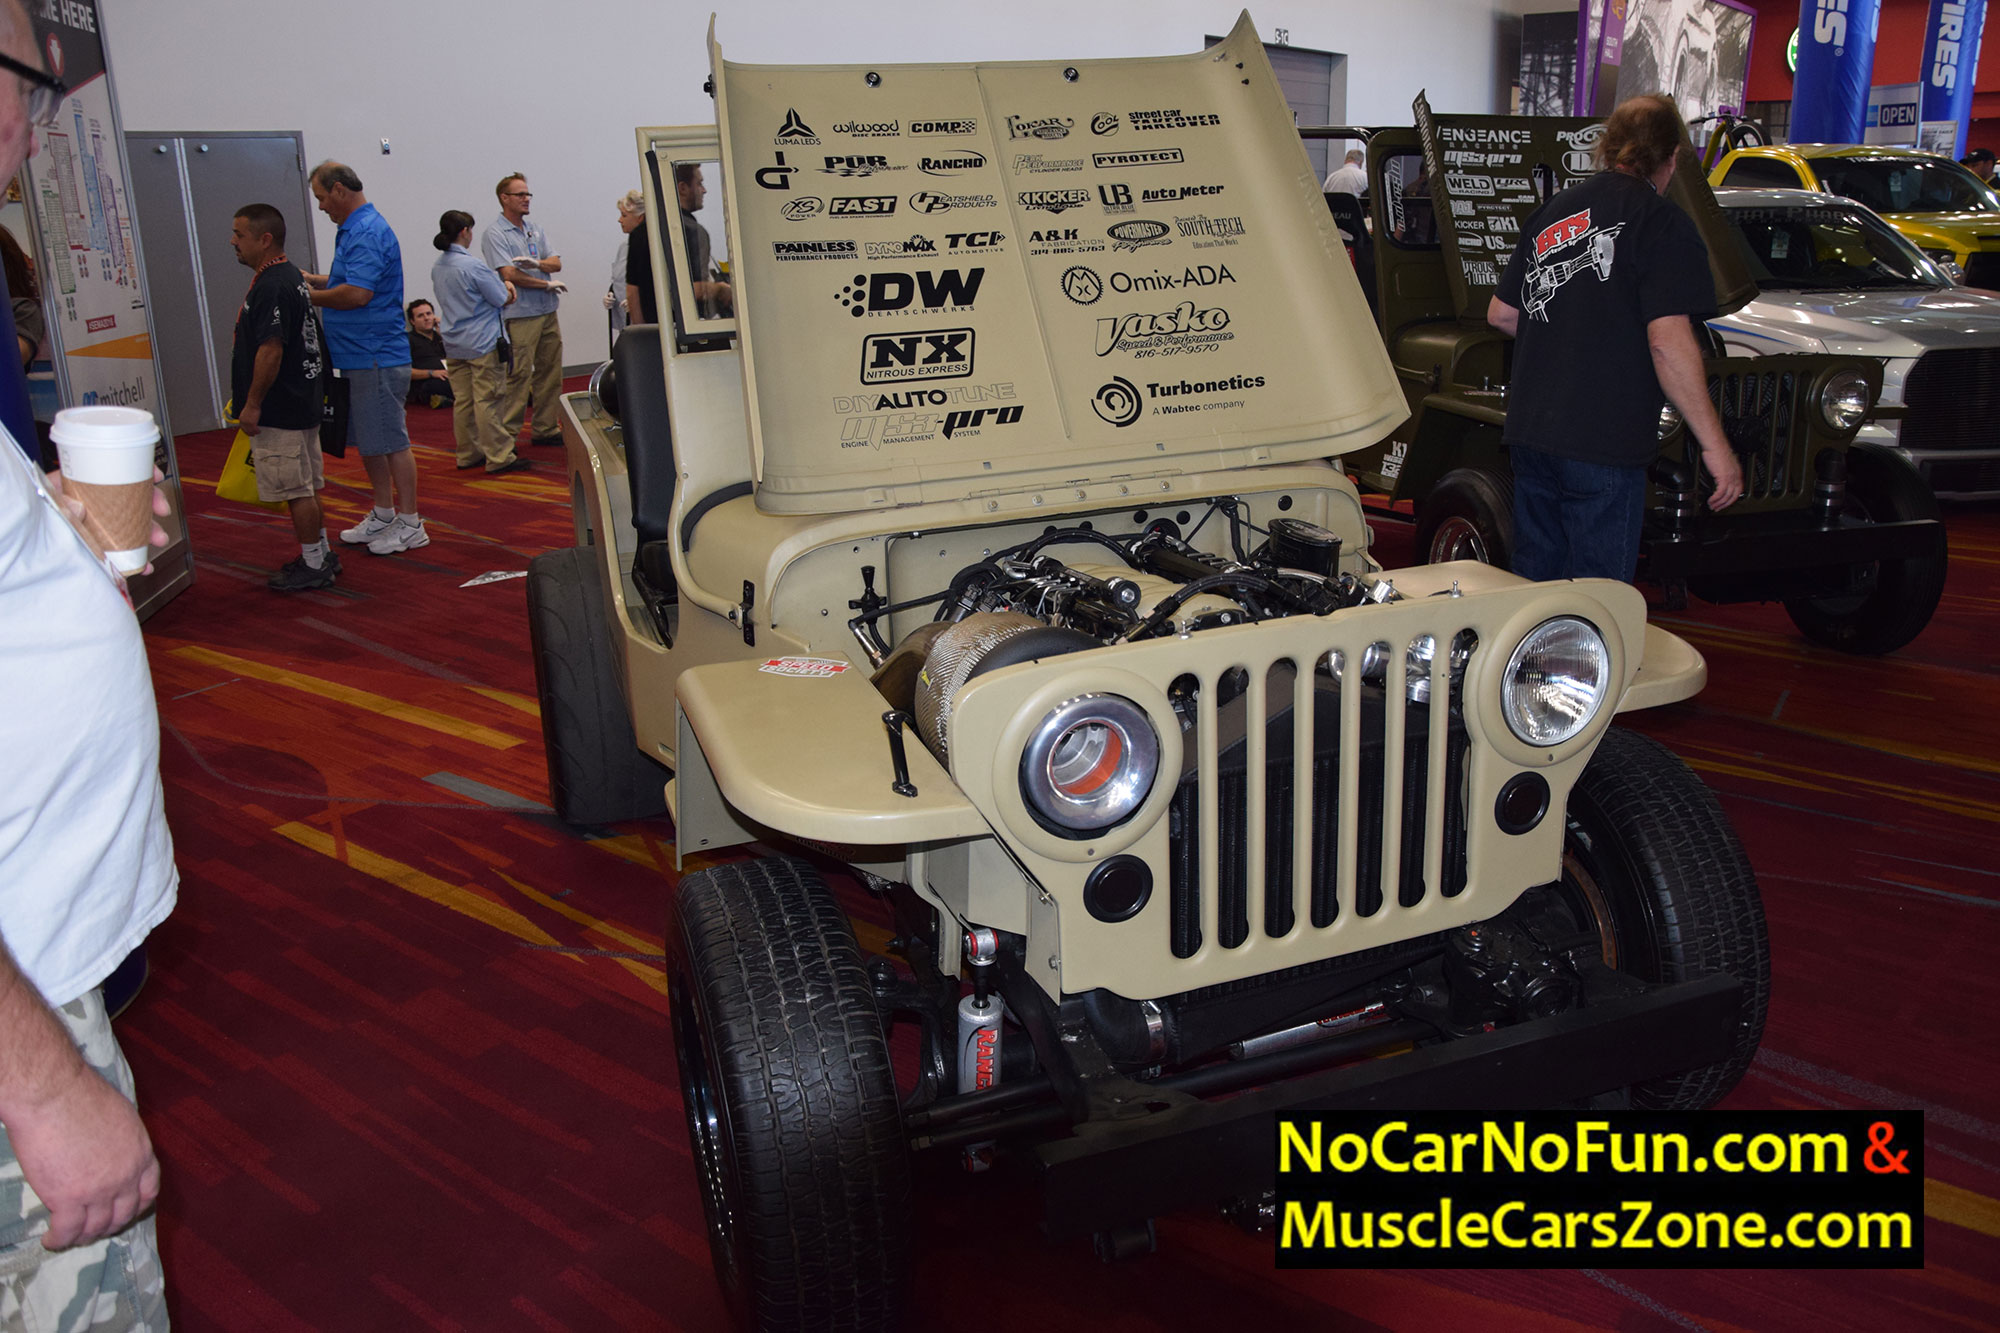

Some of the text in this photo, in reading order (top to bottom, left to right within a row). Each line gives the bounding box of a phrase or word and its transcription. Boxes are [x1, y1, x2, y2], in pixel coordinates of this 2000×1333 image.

[60, 0, 97, 33] HERE
[1932, 0, 1965, 88] IRES
[1128, 109, 1181, 120] street car
[1882, 106, 1915, 124] OPEN
[911, 122, 962, 133] COMP
[921, 157, 983, 170] RANCHO
[1096, 152, 1179, 165] PYROTECT
[1448, 177, 1491, 190] WELD
[832, 198, 896, 213] FAST
[1114, 222, 1164, 239] POWERMASTER
[1454, 220, 1485, 230] KICKER
[774, 241, 857, 254] PAINLESS
[948, 247, 1004, 255] AUTOMOTIVE
[1041, 239, 1104, 248] FABRICATION
[1110, 264, 1236, 293] Omix-ADA
[868, 268, 985, 311] DW
[868, 305, 975, 317] DEATSCHWERKS
[870, 333, 967, 369] NX
[1134, 343, 1219, 359] 816-517-9570
[866, 363, 968, 379] NITROUS EXPRESS
[100, 376, 146, 406] mitchell
[1146, 375, 1266, 398] Turbonetics
[1152, 400, 1245, 415] A Wabtec company
[841, 430, 981, 449] ENGINE MANAGEMENT SYSTEM
